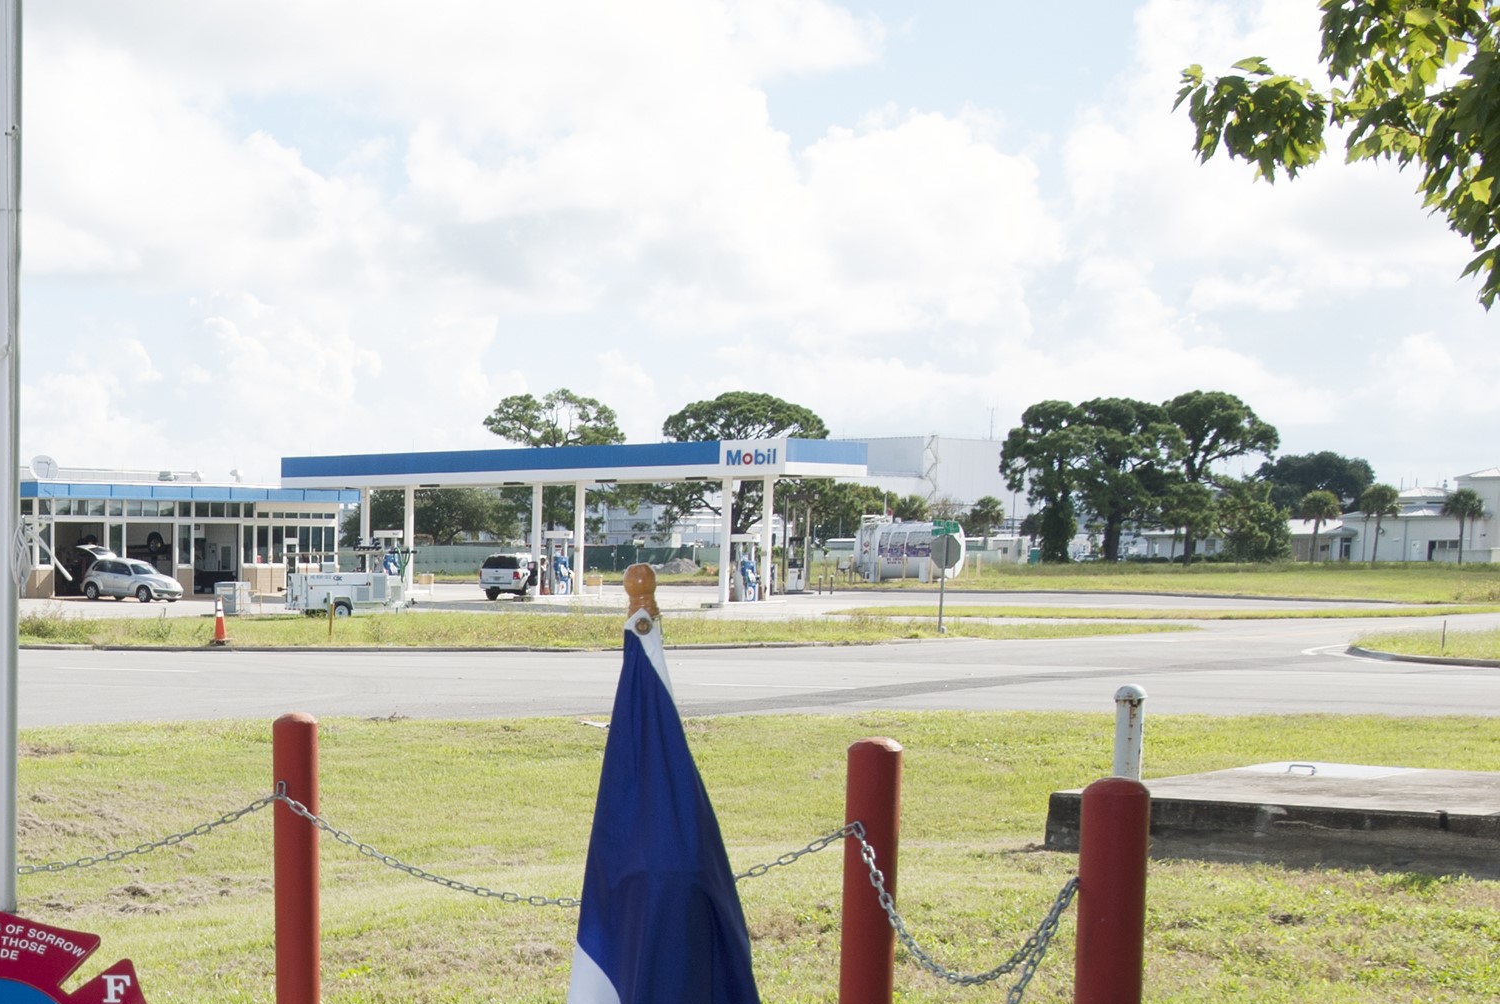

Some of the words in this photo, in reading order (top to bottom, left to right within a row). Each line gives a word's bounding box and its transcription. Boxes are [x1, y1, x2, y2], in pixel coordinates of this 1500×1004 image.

[726, 448, 777, 466] Mobil
[1, 935, 47, 955] THOSE
[5, 924, 24, 935] OF
[27, 928, 86, 958] SORROW
